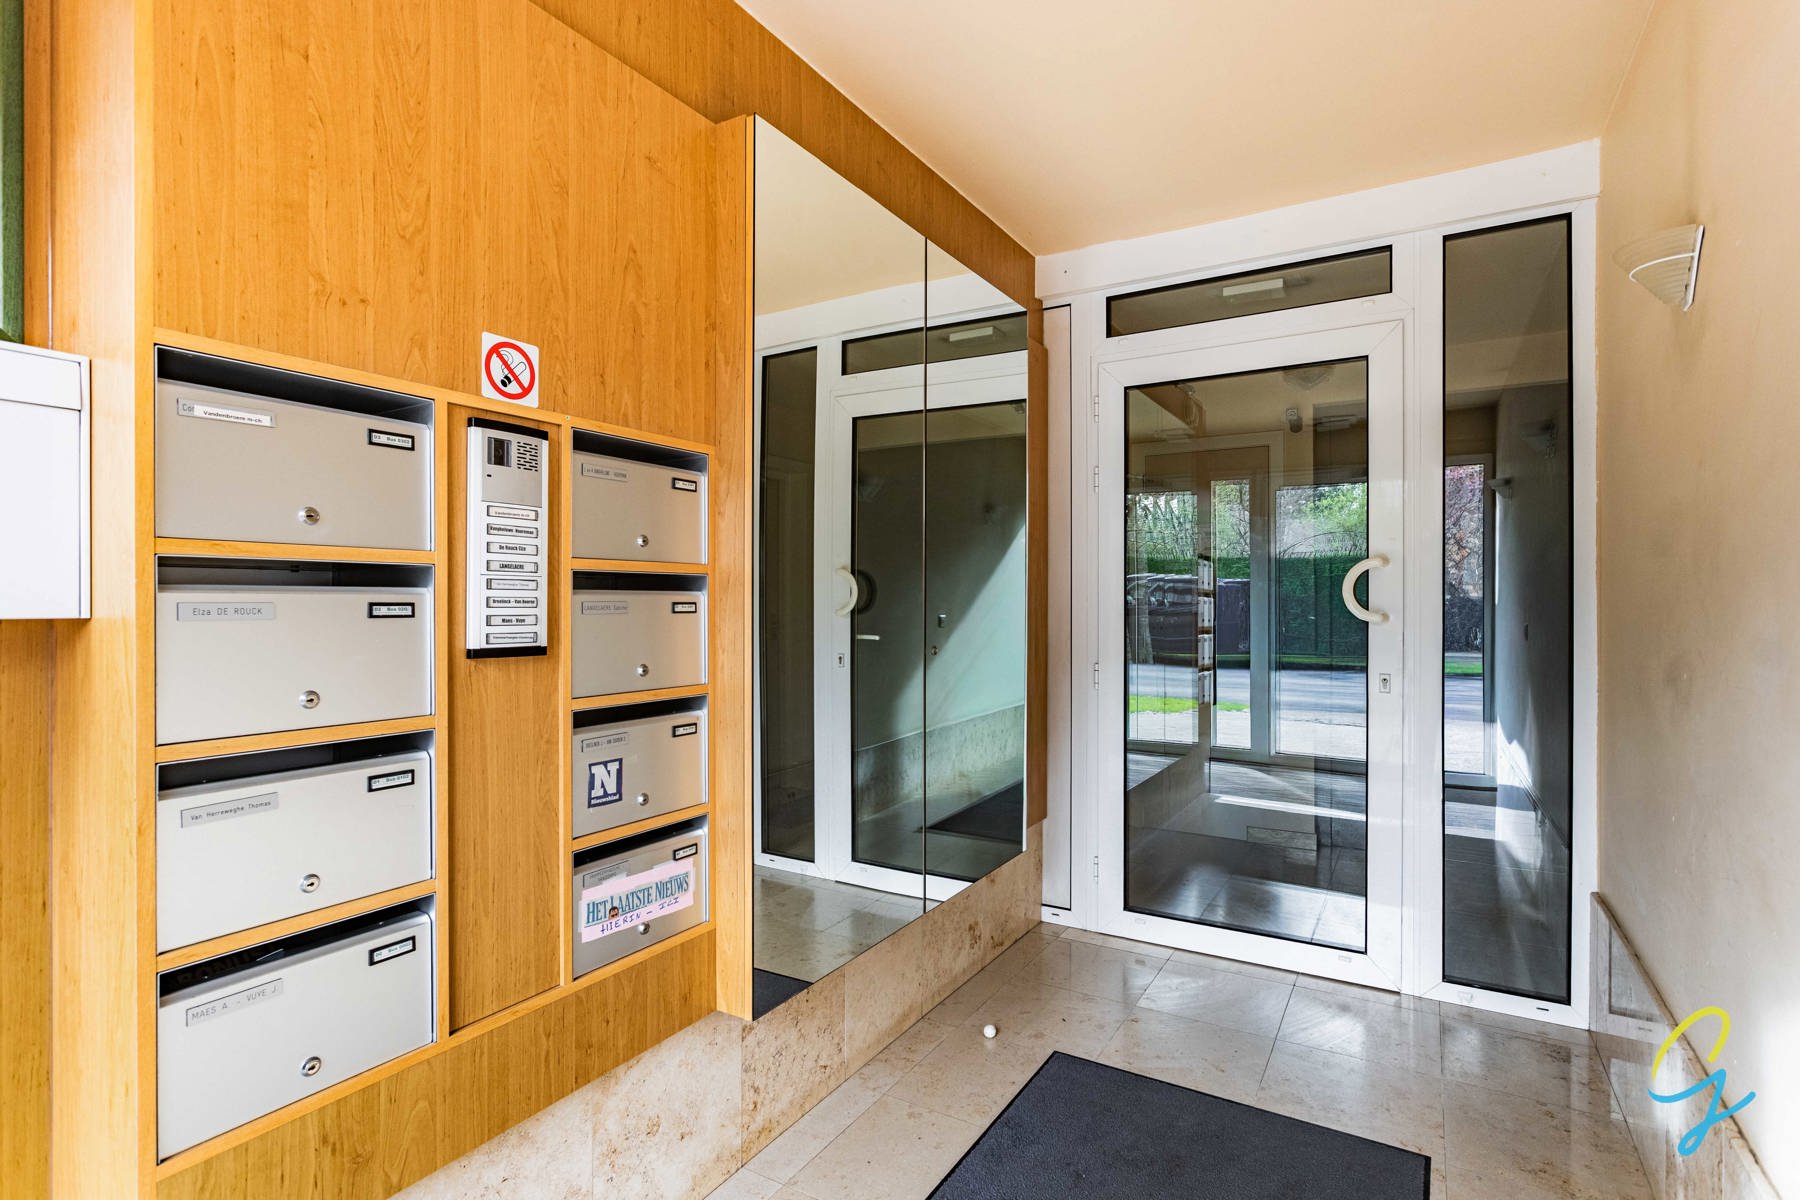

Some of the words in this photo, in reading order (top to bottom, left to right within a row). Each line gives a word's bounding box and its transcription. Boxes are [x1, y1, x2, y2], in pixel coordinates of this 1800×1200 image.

[192, 608, 212, 616] Elza
[217, 608, 228, 616] DE
[234, 608, 262, 616] ROUCK
[591, 761, 620, 798] N
[248, 801, 272, 809] Thomas
[590, 793, 620, 805] Nieuwsblad
[586, 899, 608, 924] HET
[655, 873, 689, 902] NIEUWS
[600, 912, 641, 934] HIERIN
[191, 1006, 217, 1020] MAES
